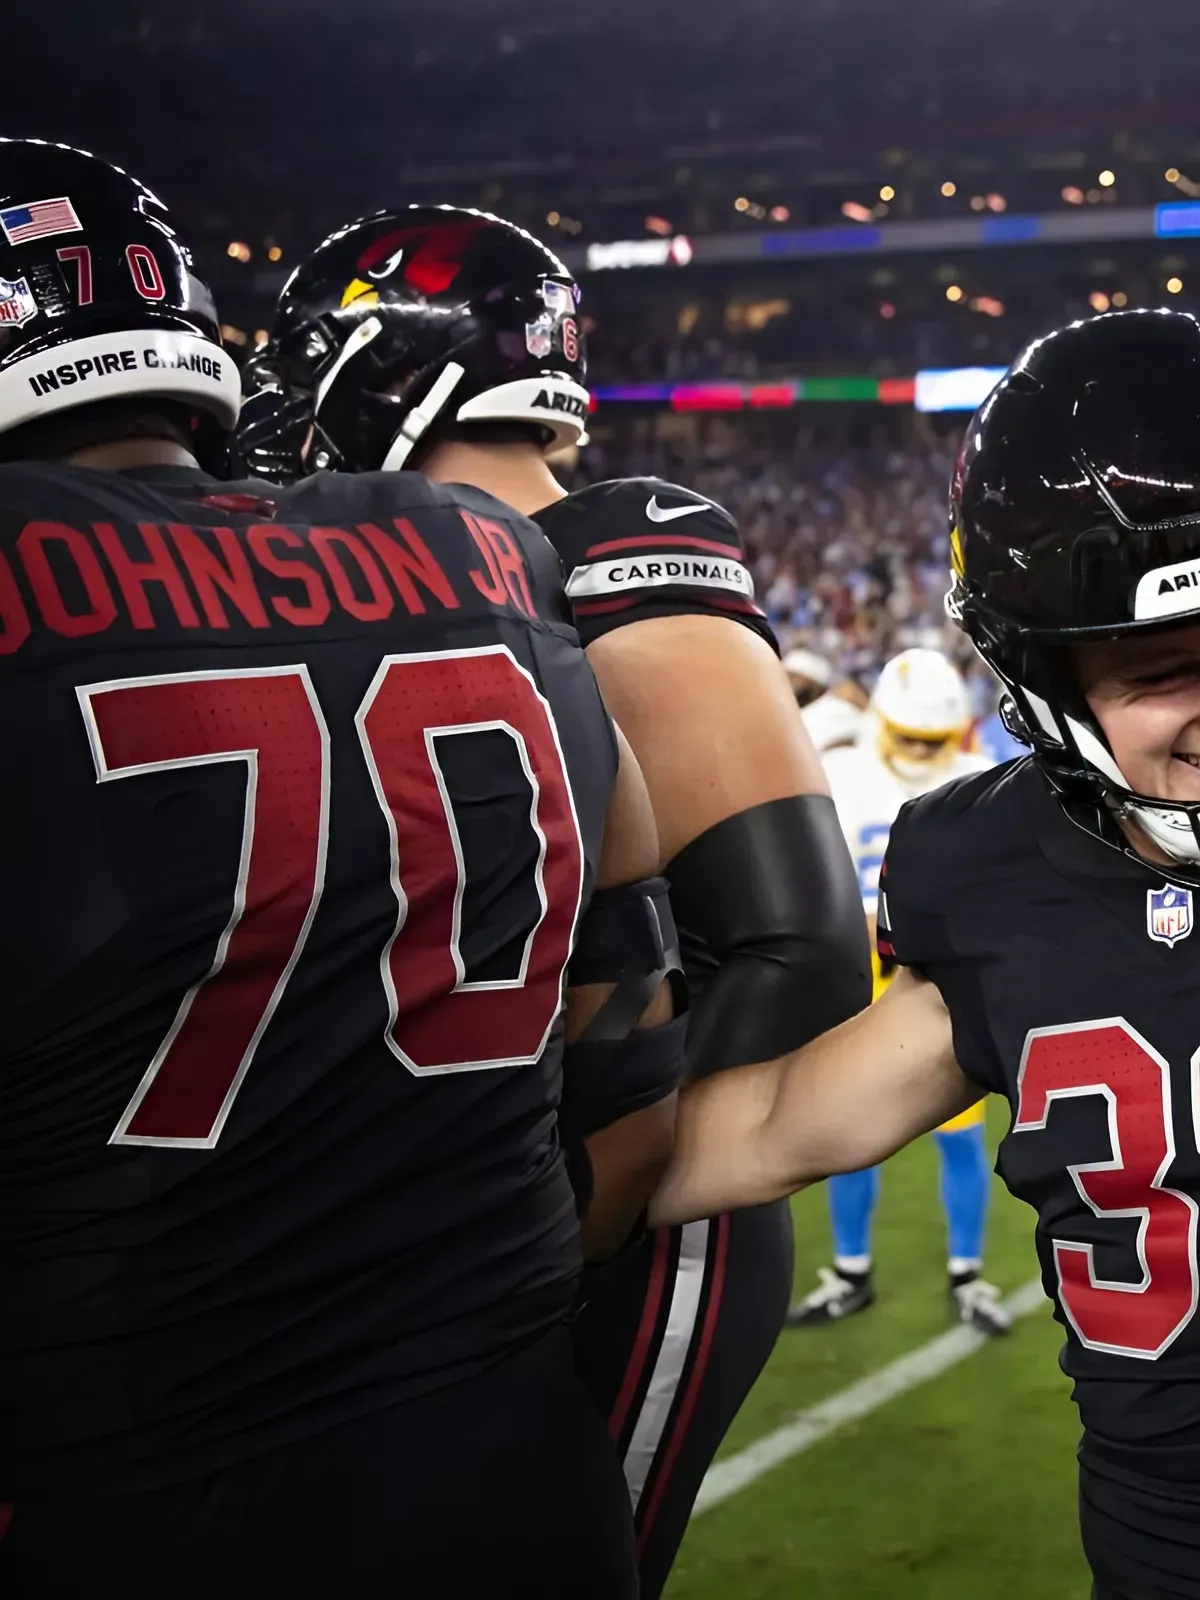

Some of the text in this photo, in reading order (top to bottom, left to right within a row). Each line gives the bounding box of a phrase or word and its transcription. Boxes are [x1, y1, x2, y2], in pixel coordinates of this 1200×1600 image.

[28, 348, 222, 397] INSPIRE CHANGE
[459, 508, 538, 618] JR
[608, 562, 744, 584] CARDINALS
[75, 643, 585, 1149] 70
